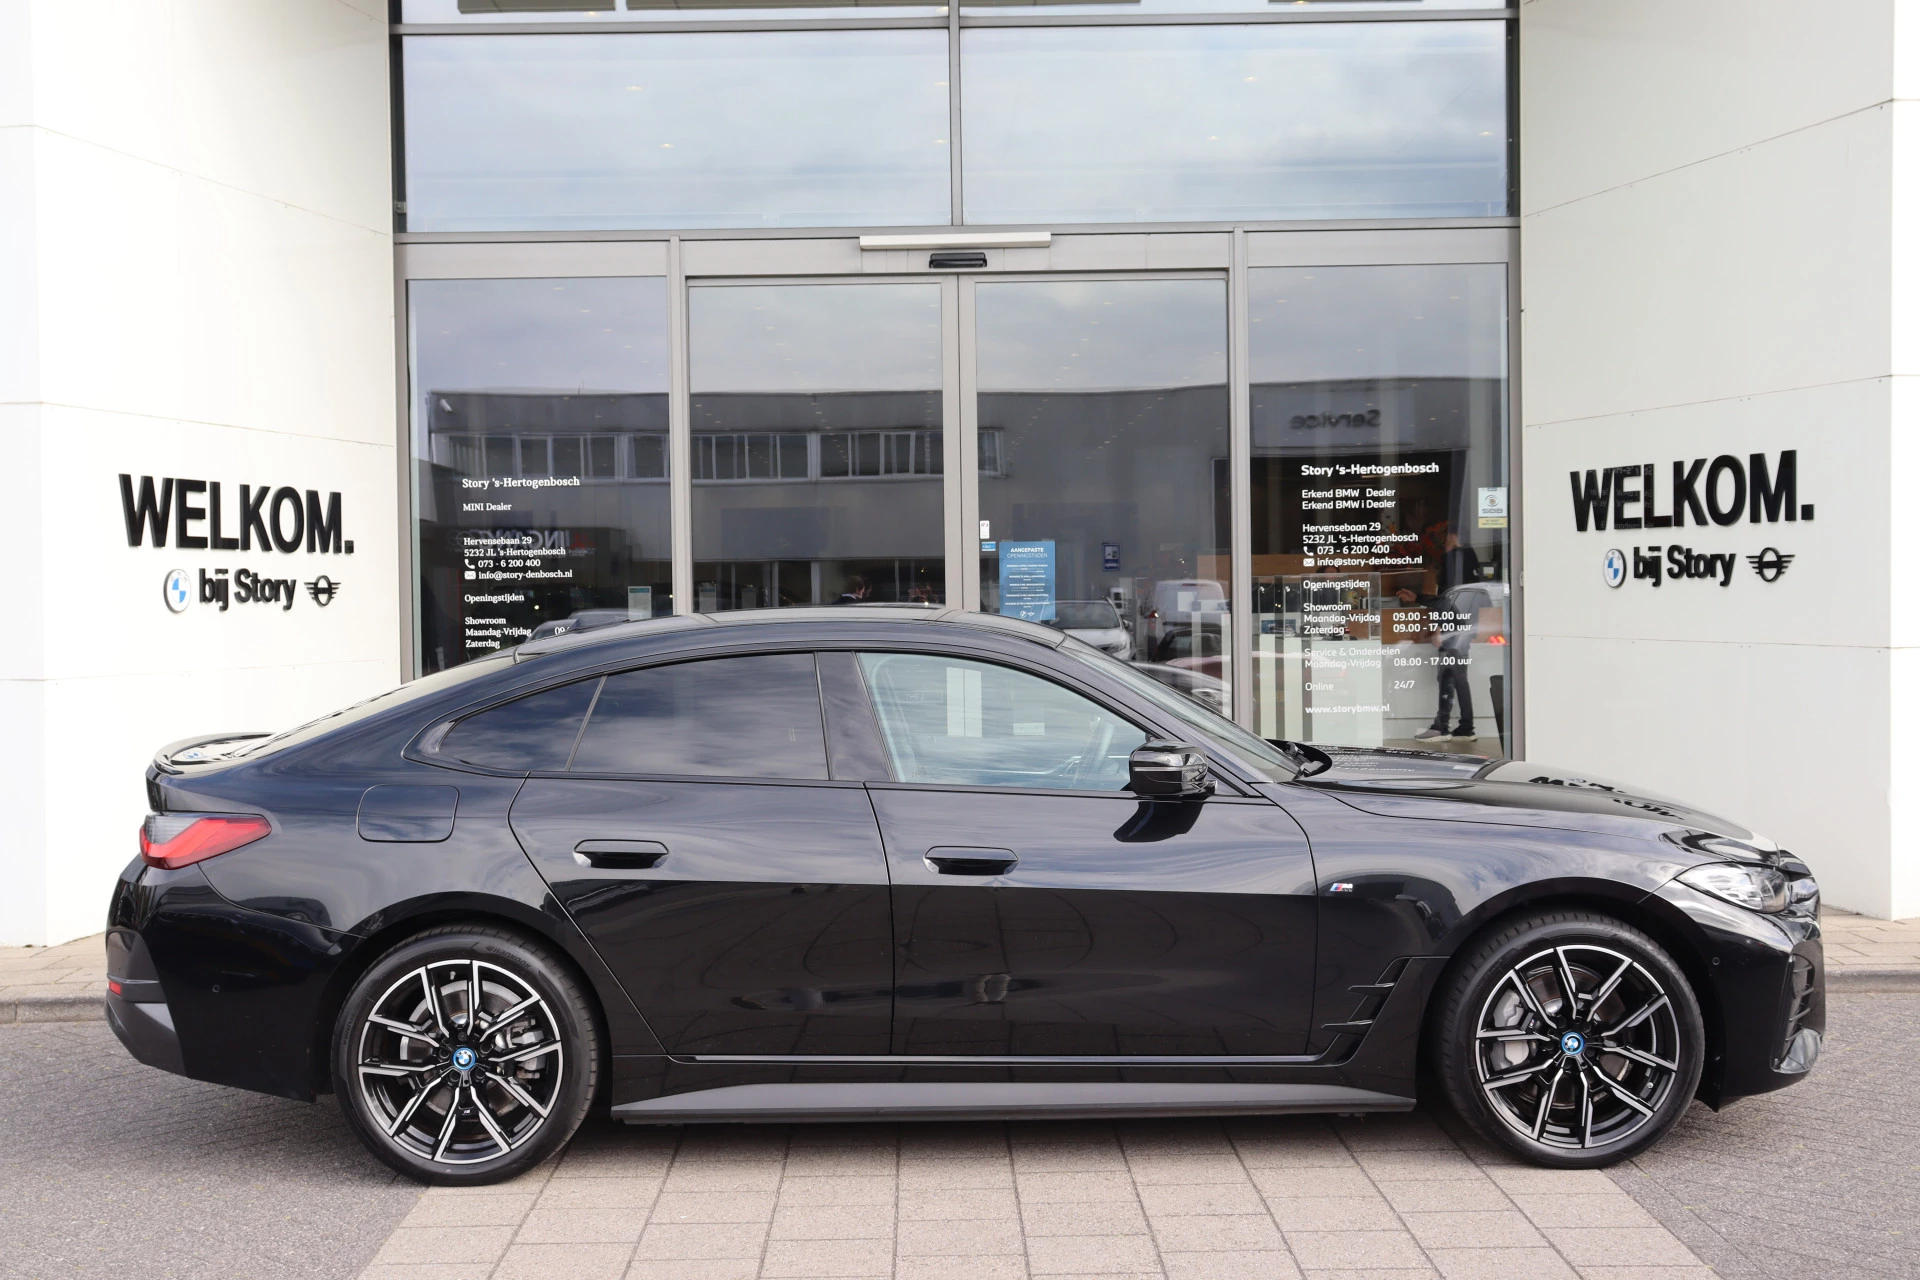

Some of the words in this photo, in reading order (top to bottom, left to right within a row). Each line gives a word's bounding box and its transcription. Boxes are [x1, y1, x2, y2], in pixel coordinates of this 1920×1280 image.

[1301, 465, 1334, 477] Story
[462, 478, 490, 490] Story
[1301, 489, 1334, 498] Erkend
[1335, 488, 1360, 497] BMW
[1365, 488, 1396, 497] Dealer
[1569, 449, 1814, 532] WELKOM.
[463, 503, 484, 511] MINI
[486, 502, 512, 511] Dealer
[1302, 500, 1334, 509] Erkend
[1335, 499, 1360, 509] BMW
[1361, 500, 1365, 508] i
[1366, 499, 1396, 508] Dealer
[118, 473, 354, 554] WELKOM.
[1302, 523, 1368, 532] Hervensebaan
[1369, 522, 1381, 531] 29
[463, 536, 520, 546] Hervensebaan
[521, 536, 533, 544] 29
[1302, 535, 1325, 544] 5232
[1326, 534, 1337, 544] JL
[464, 548, 485, 557] 5232
[486, 548, 496, 556] JL
[1317, 546, 1334, 555] 073
[1342, 545, 1349, 554] 6
[1350, 545, 1369, 554] 200
[1371, 545, 1390, 554] 400
[478, 559, 494, 568] 073
[500, 559, 506, 568] 6
[508, 559, 523, 567] 200
[525, 559, 541, 567] 400
[1317, 556, 1423, 567] info@story-denbosch.nl
[1633, 546, 1662, 587] bij
[1667, 545, 1736, 587] Story
[478, 569, 573, 580] info@story-denbosch.nl
[199, 568, 229, 612] bij
[234, 568, 296, 612] Story
[1303, 579, 1371, 590] Openingstijden
[464, 593, 525, 604] Openingstijden
[1303, 602, 1352, 612] Showroom
[465, 617, 507, 625] Showroom
[1303, 614, 1381, 624] Maandag-Vrijdag
[1393, 612, 1421, 621] 09.00
[1428, 611, 1454, 621] 18.00
[1456, 612, 1472, 620] uur
[465, 627, 532, 638] Maandag-Vrijdag
[1303, 625, 1345, 635] Zaterdag
[1393, 623, 1421, 632] 09.00
[1456, 623, 1472, 631] uur
[465, 639, 501, 649] Zaterdag
[1304, 648, 1338, 657] Service
[1339, 648, 1347, 657] &
[1348, 647, 1400, 656] Onderdelen
[1304, 659, 1382, 669] Maandag-Vrijdag
[1393, 657, 1422, 666] 08.00
[1457, 657, 1473, 665] uur
[1305, 682, 1335, 691] Online
[1394, 680, 1415, 690] 24/7
[1305, 703, 1391, 715] www.storybmw.nl
